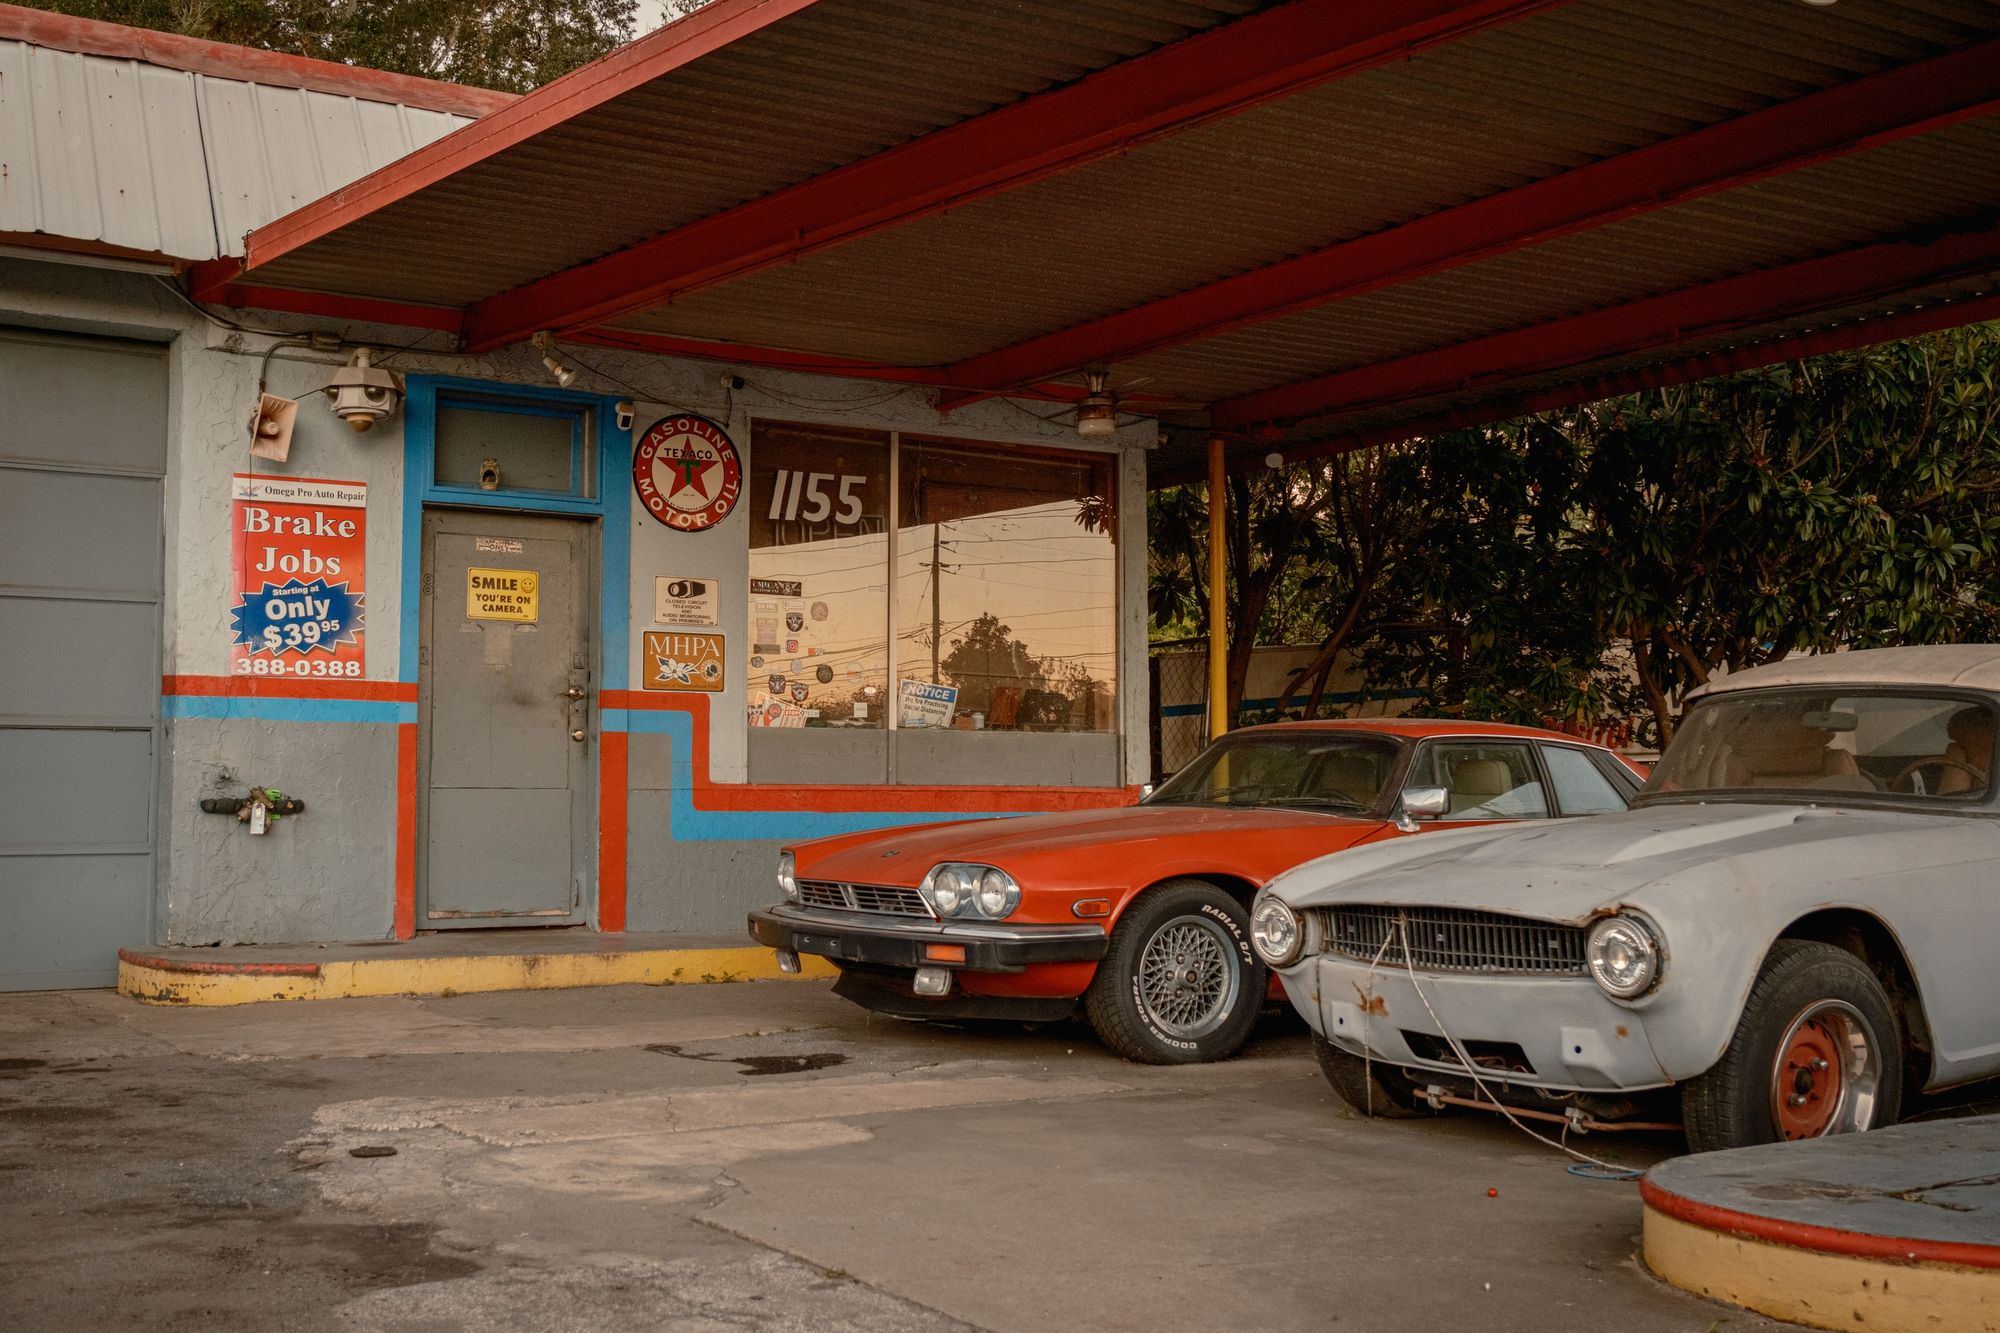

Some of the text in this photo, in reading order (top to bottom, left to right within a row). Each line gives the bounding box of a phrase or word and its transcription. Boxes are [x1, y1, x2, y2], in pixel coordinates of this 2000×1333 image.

[640, 418, 736, 463] GASOLINE
[664, 447, 713, 460] TEXACO
[264, 485, 365, 502] Omega Pro Auto Repair
[640, 477, 738, 528] MOTOR OIL
[768, 469, 868, 525] 1155
[242, 506, 357, 539] Brake
[255, 546, 341, 576] Jobs
[272, 585, 320, 597] Starting at
[471, 576, 518, 591] SMILE
[265, 595, 331, 621] Only
[476, 593, 531, 605] YOU'RE ON
[482, 604, 523, 614] CAMERA
[649, 635, 720, 657] MHPA
[236, 658, 361, 677] 388-0388
[906, 683, 951, 700] NOTICE
[904, 703, 947, 717] Social Distancing
[1201, 904, 1242, 939] RADIAL
[1132, 975, 1198, 1049] COOPER COBRA
